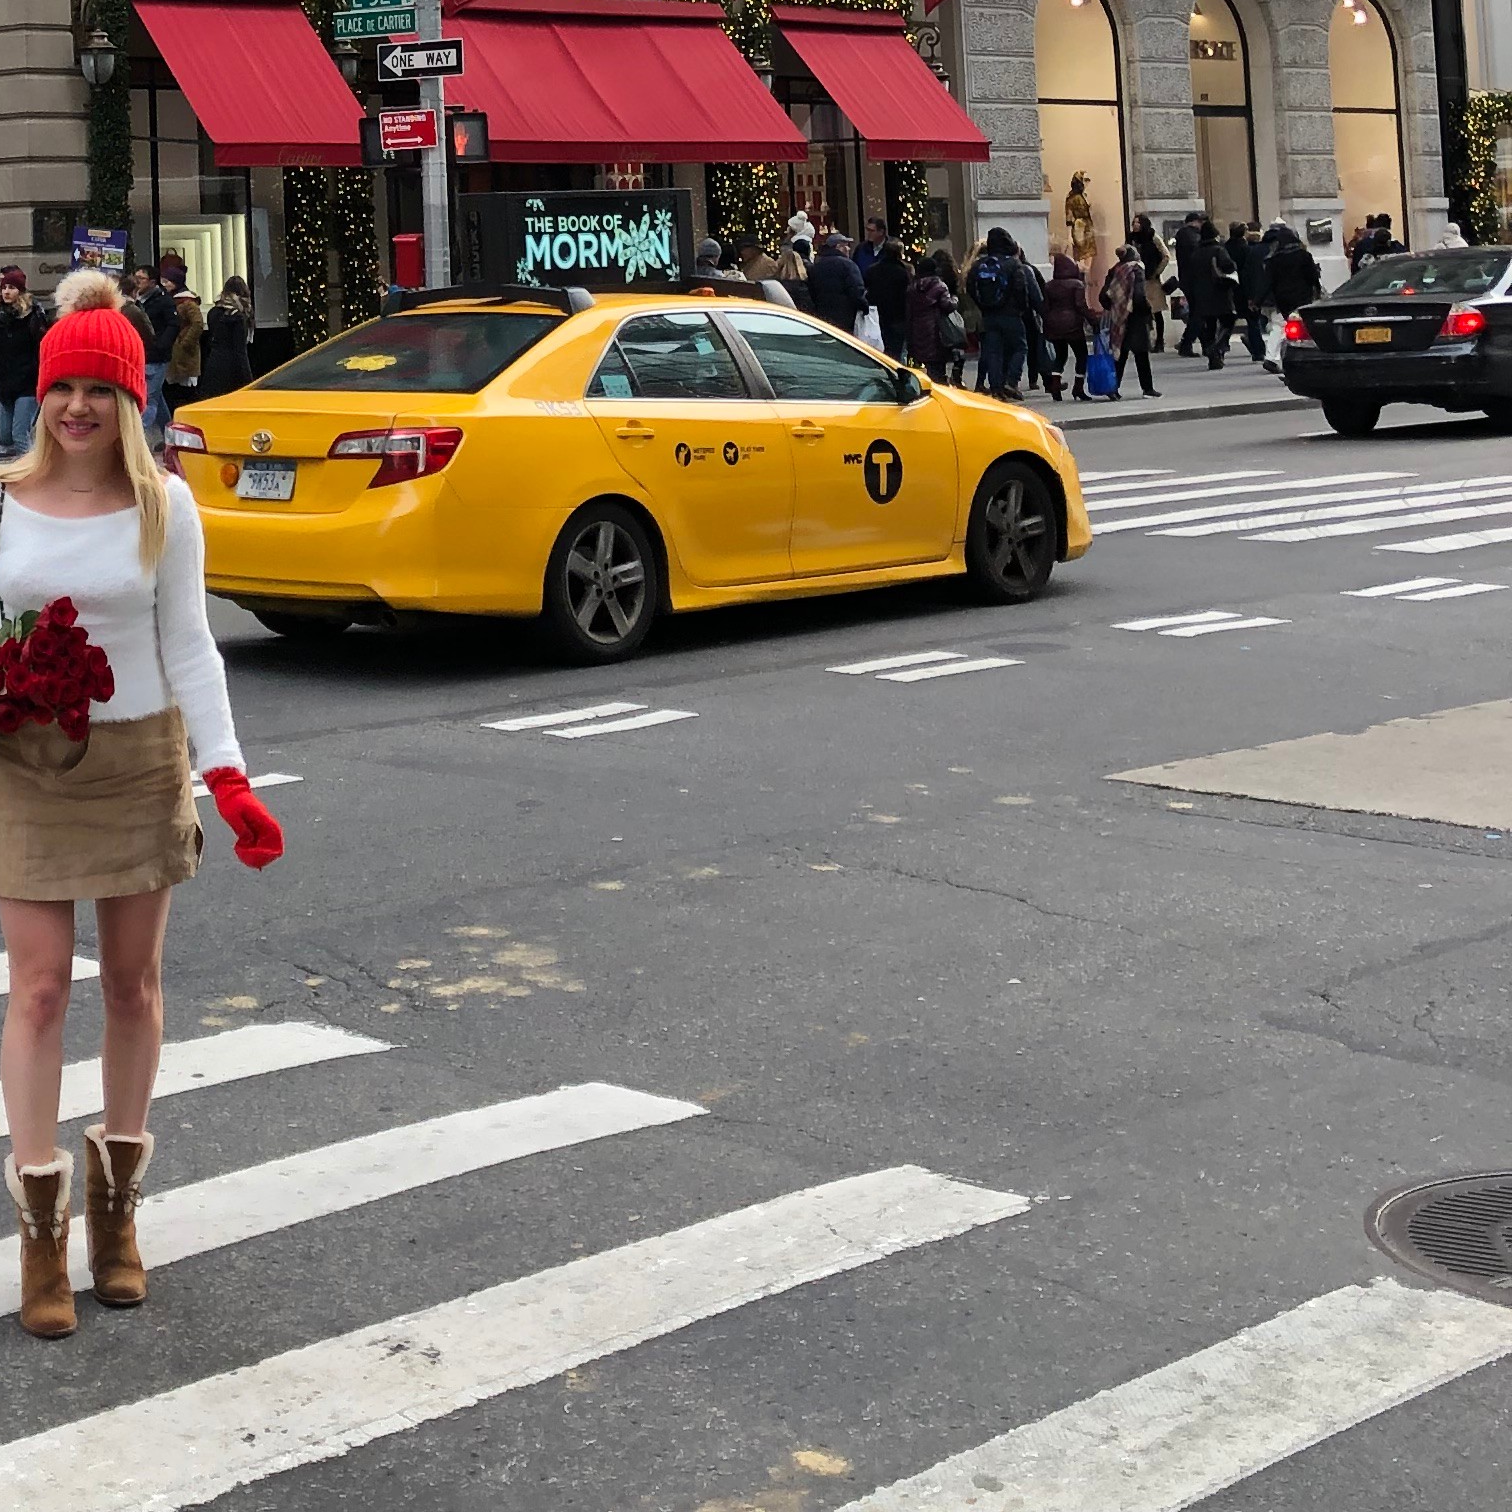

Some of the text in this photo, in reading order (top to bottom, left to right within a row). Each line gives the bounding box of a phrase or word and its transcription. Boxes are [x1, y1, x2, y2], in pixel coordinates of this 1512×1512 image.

[337, 17, 364, 34] PLACE
[377, 13, 411, 31] CARTIER
[391, 51, 451, 69] ONE WAY
[393, 113, 427, 124] STANDING
[525, 214, 623, 233] THE BOOK OF
[525, 229, 672, 271] MORMN
[843, 453, 862, 465] NYC
